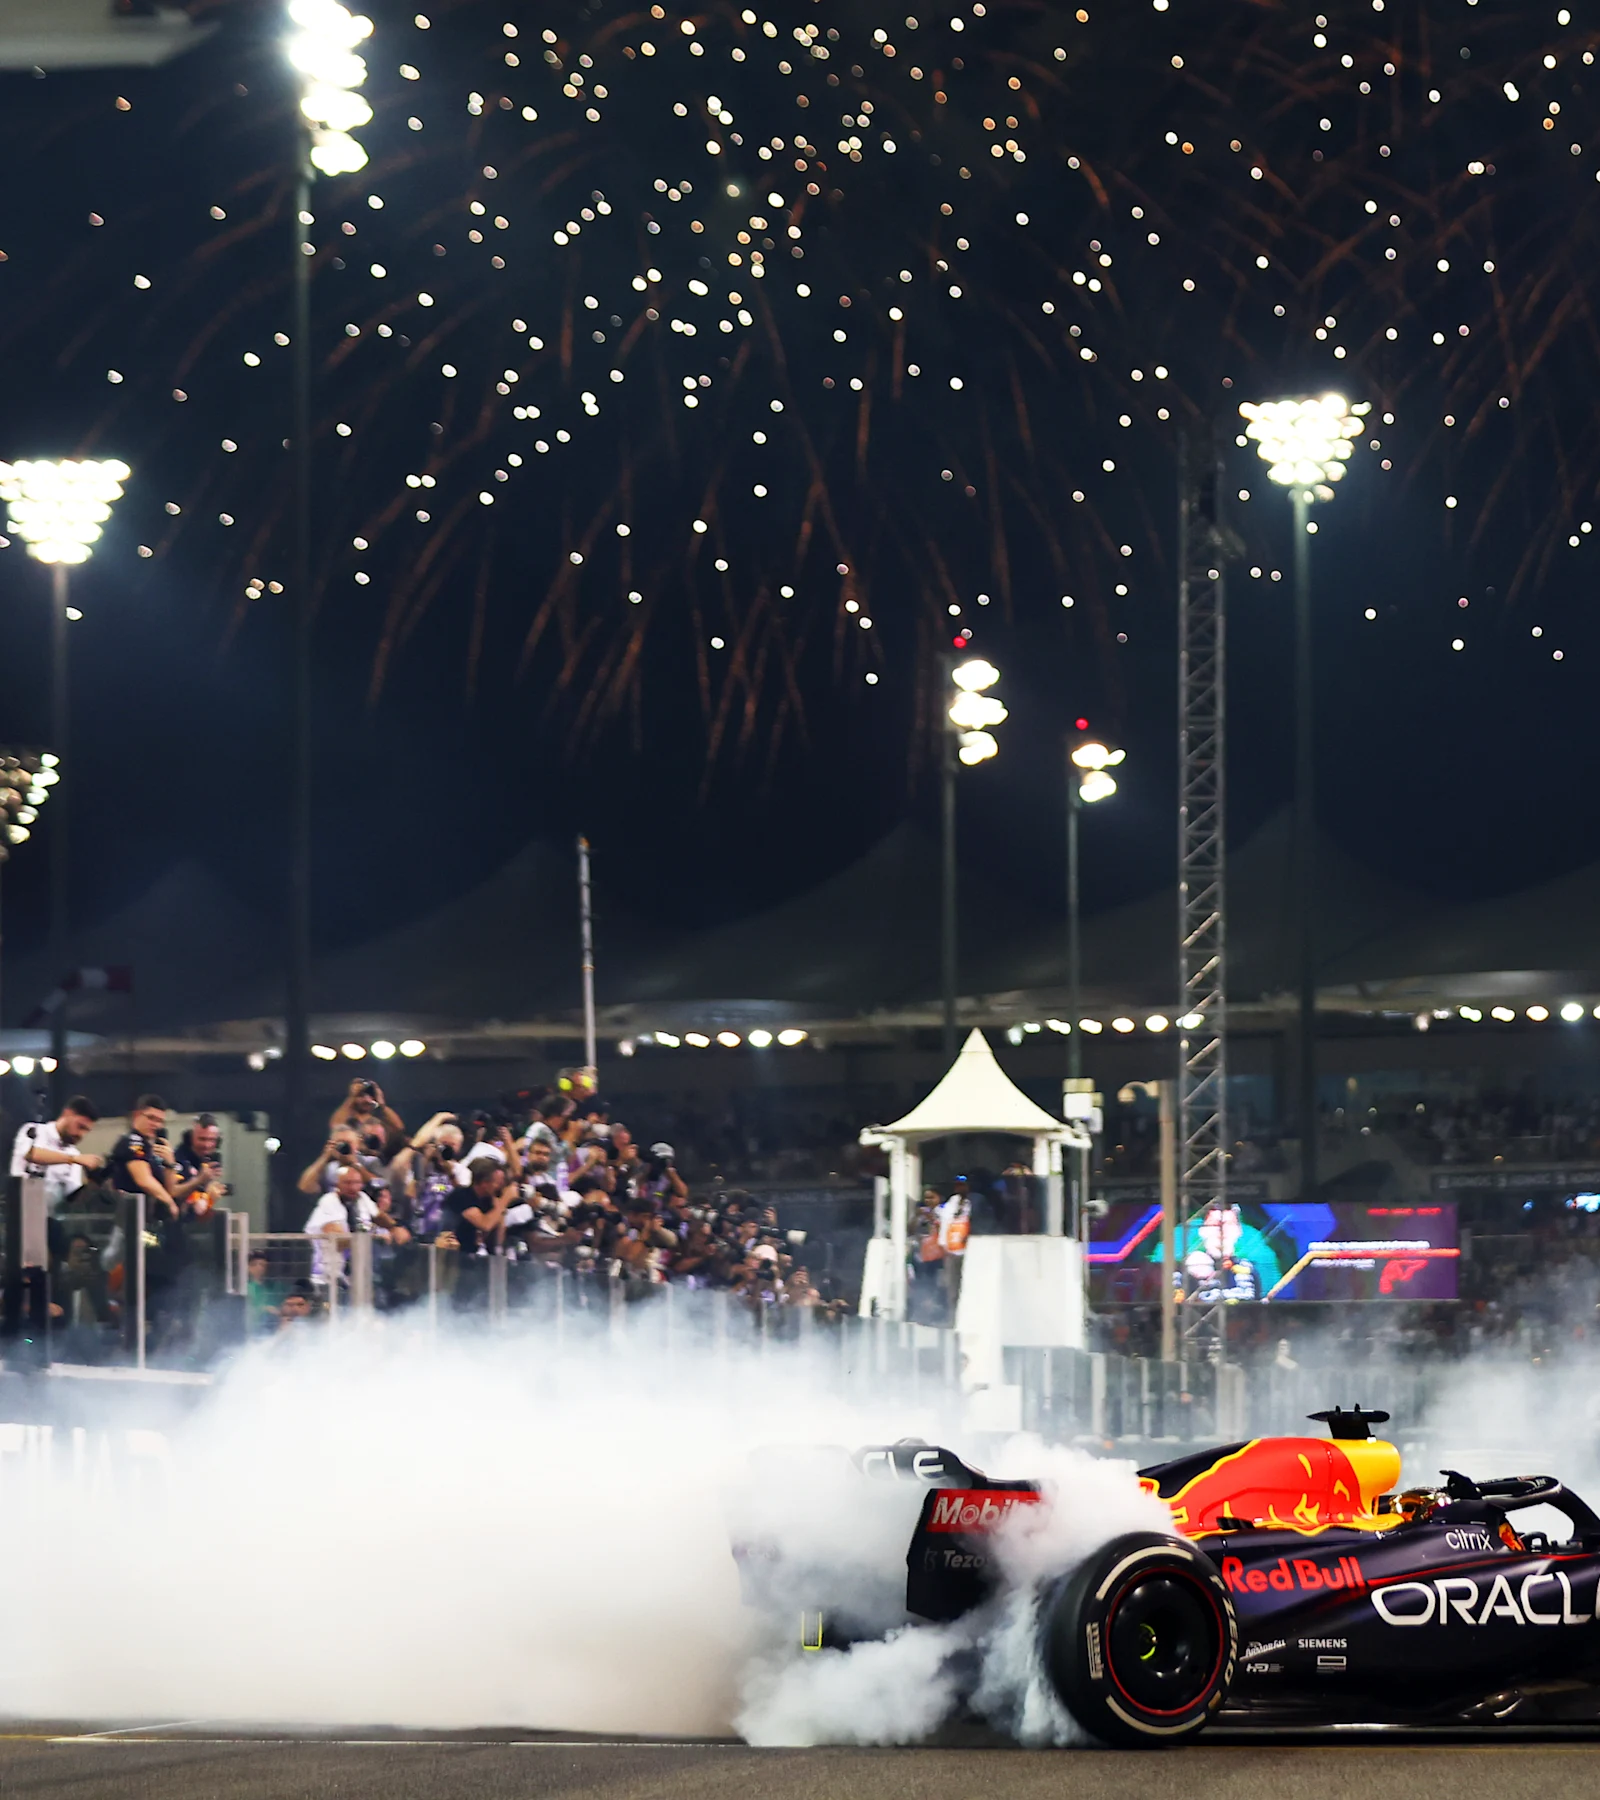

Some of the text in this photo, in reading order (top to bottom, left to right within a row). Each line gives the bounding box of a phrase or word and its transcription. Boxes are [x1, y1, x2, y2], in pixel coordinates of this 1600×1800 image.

[1445, 1528, 1494, 1551] citrix
[1221, 1556, 1366, 1593] Red Bull
[1298, 1638, 1347, 1649] SIEMENS
